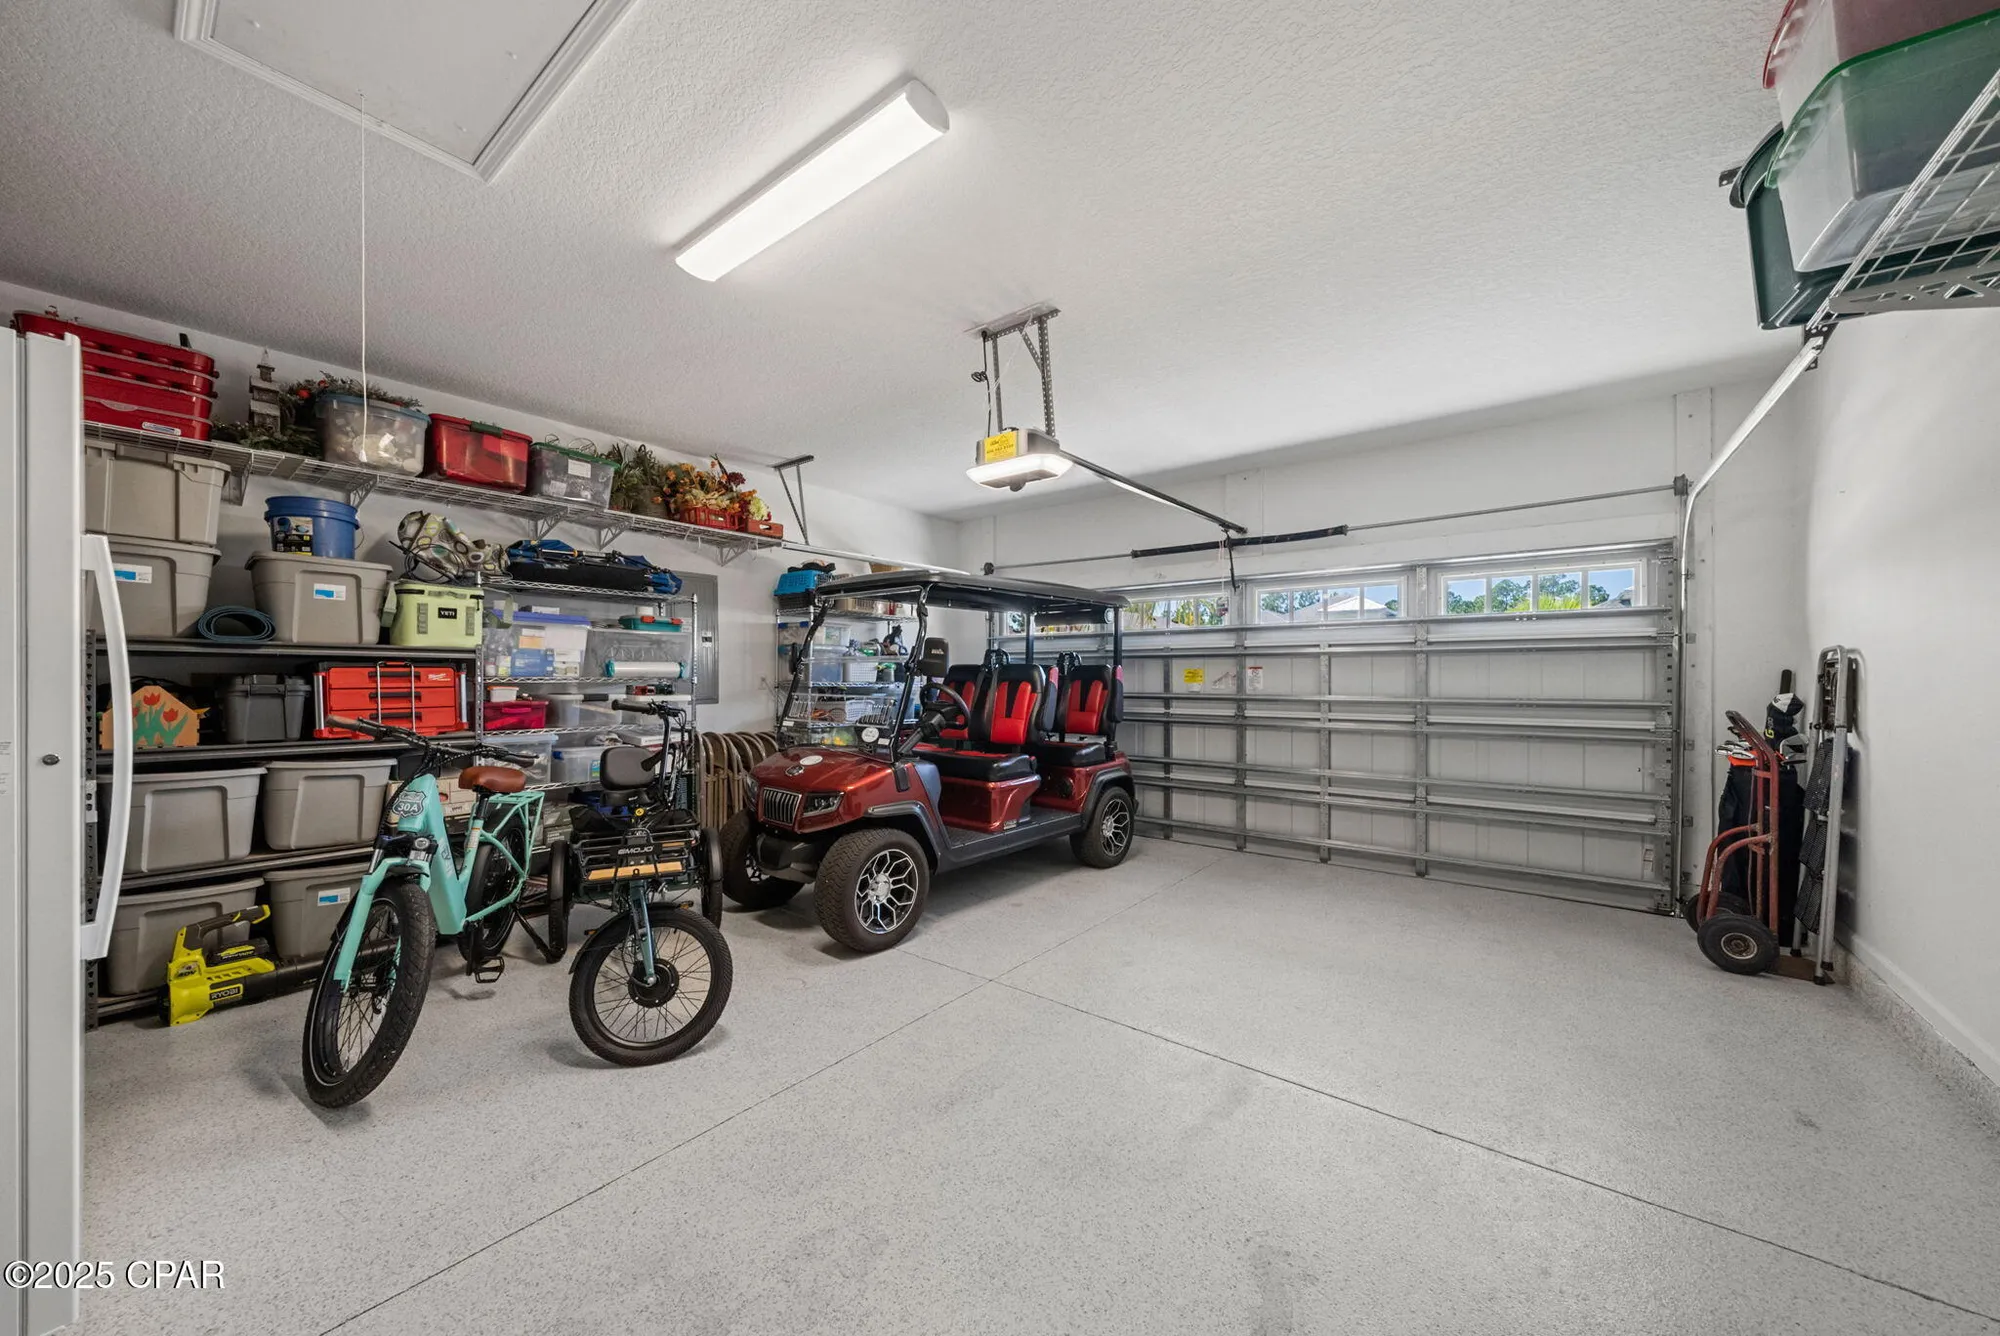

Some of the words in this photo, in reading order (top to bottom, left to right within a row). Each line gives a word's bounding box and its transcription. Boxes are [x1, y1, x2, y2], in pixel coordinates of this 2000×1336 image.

[397, 802, 419, 812] 30A
[617, 846, 654, 855] EMOJO
[211, 987, 239, 999] RYOBI
